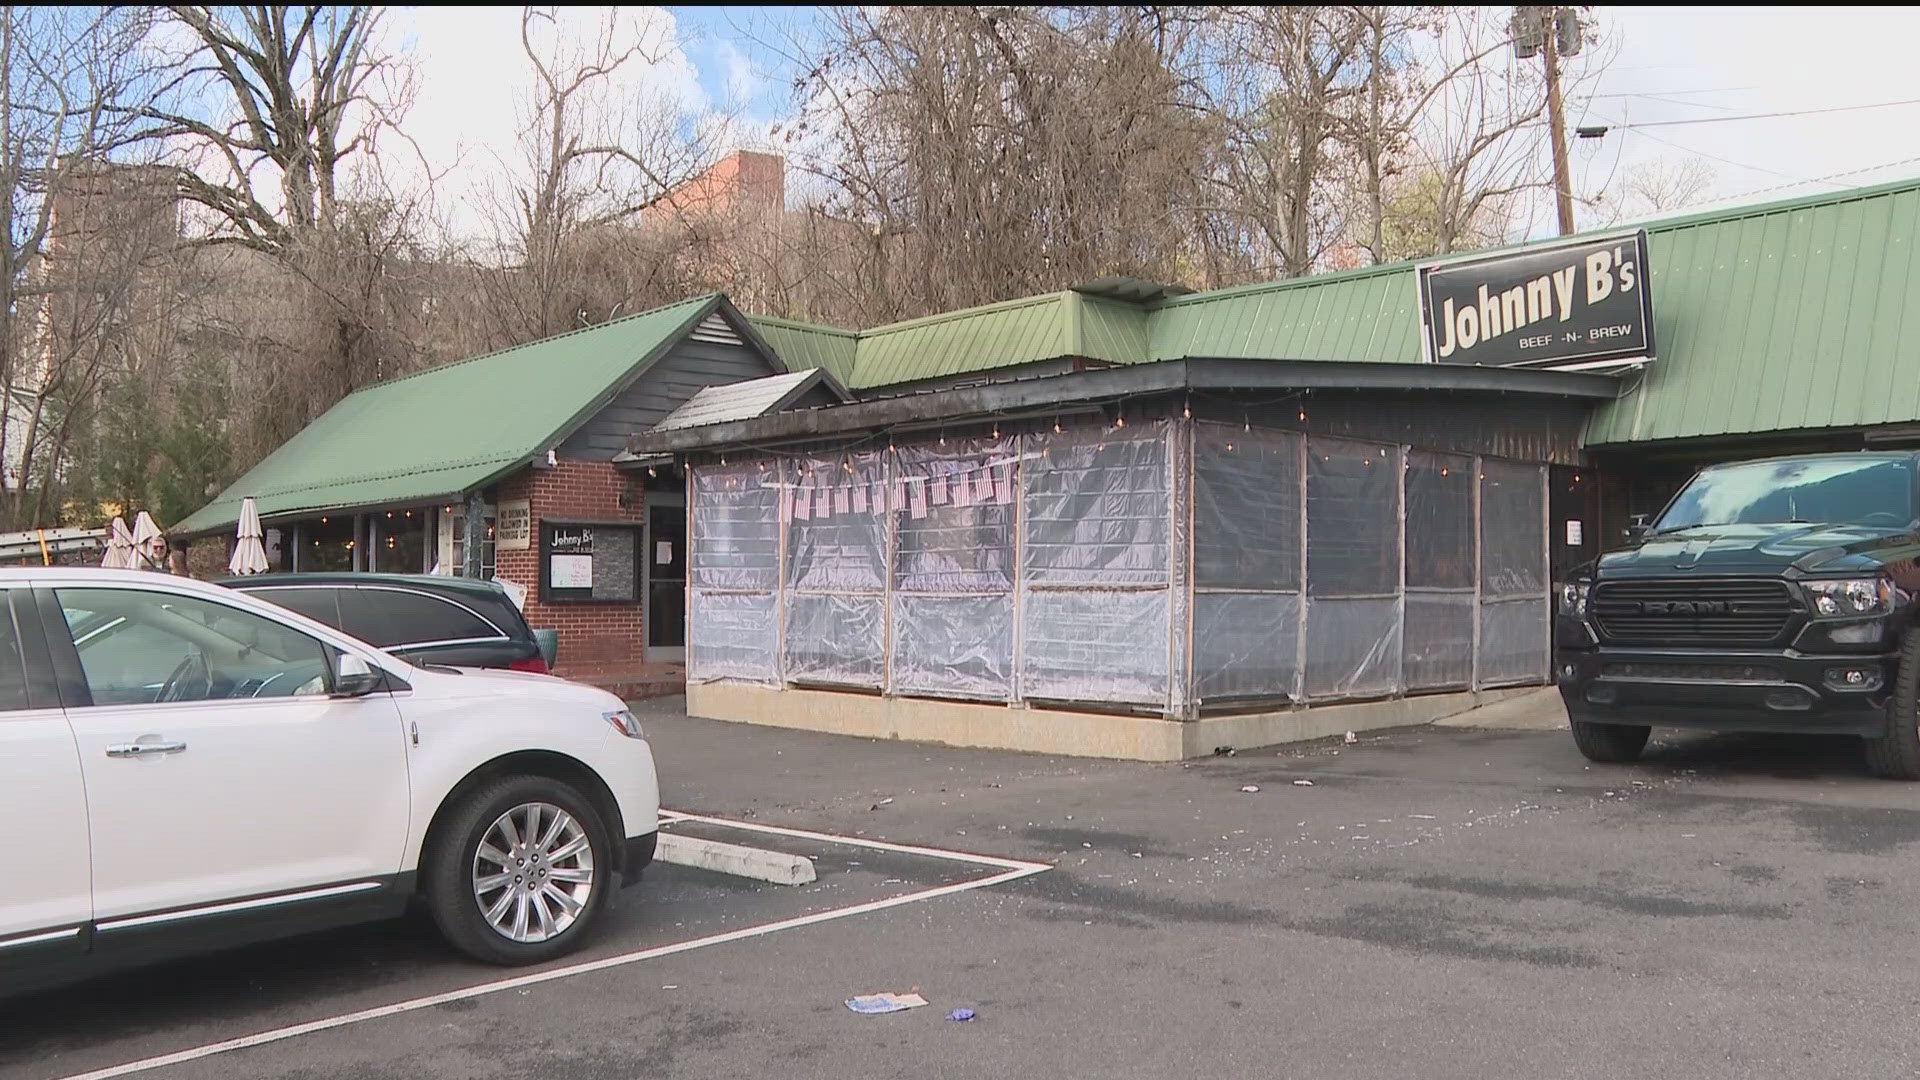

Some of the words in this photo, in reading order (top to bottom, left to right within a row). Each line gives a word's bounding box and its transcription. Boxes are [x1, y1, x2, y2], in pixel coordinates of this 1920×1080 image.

[1439, 265, 1576, 358] Johnny
[1585, 246, 1635, 305] B's
[1519, 334, 1552, 349] BEEF
[1561, 331, 1582, 343] -N-
[1589, 324, 1632, 340] BREW
[500, 520, 521, 530] ALLOWED
[499, 530, 518, 540] PARKING
[520, 529, 529, 539] LOT
[551, 529, 581, 547] Johnny
[1644, 600, 1726, 614] RAM
